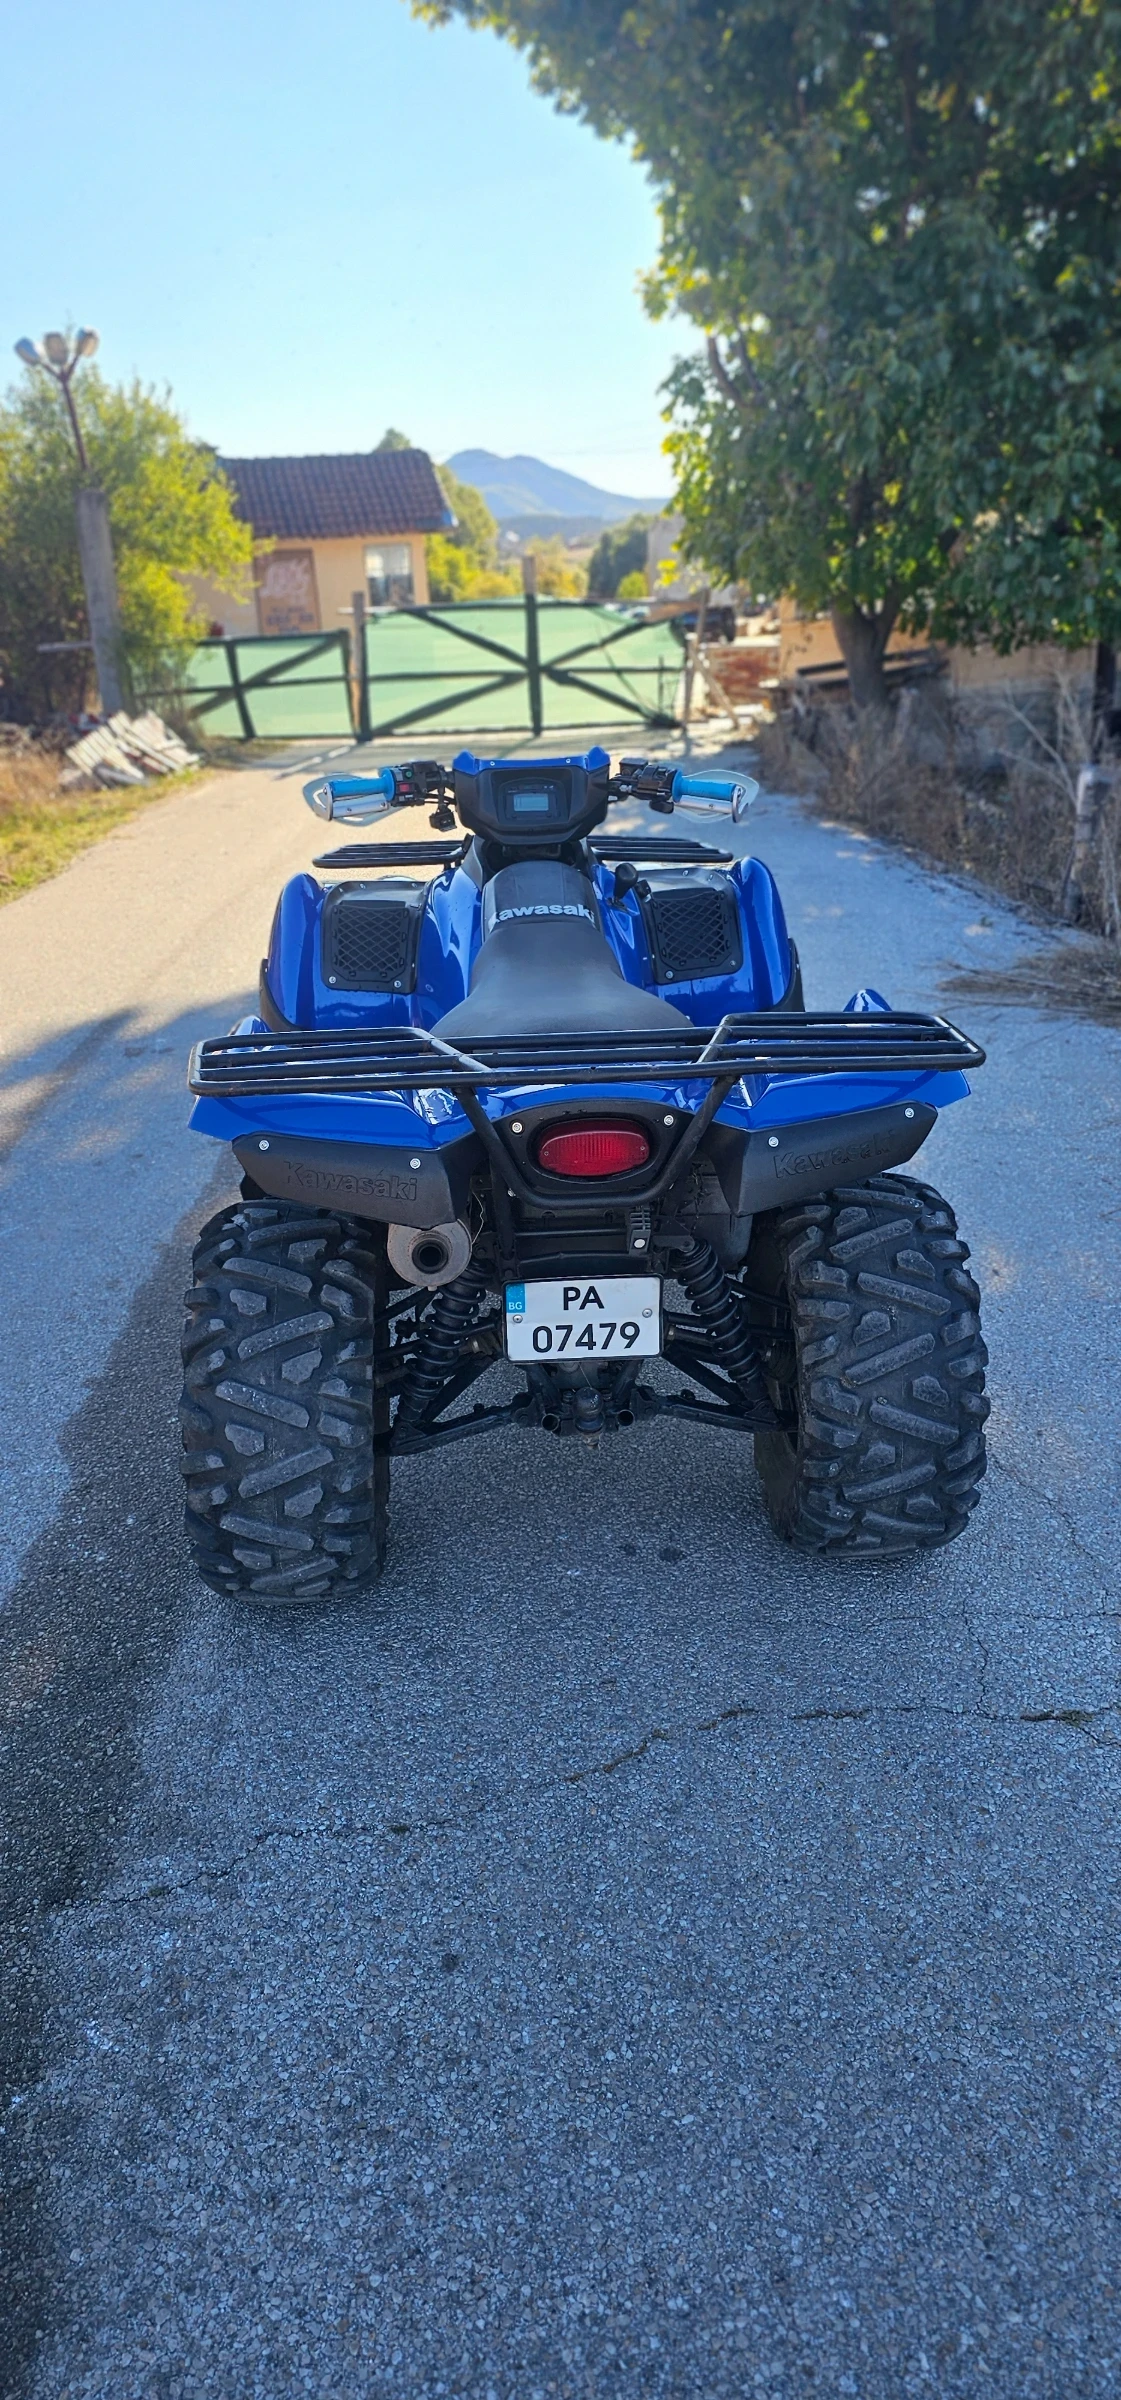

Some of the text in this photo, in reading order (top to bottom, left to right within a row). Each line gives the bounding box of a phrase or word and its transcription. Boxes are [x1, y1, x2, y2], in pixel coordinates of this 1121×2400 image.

[773, 1129, 896, 1179] Kawasaki
[284, 1161, 418, 1201] Kawasaki
[508, 1301, 523, 1311] BG
[563, 1285, 605, 1311] PA
[532, 1321, 641, 1354] 07479
